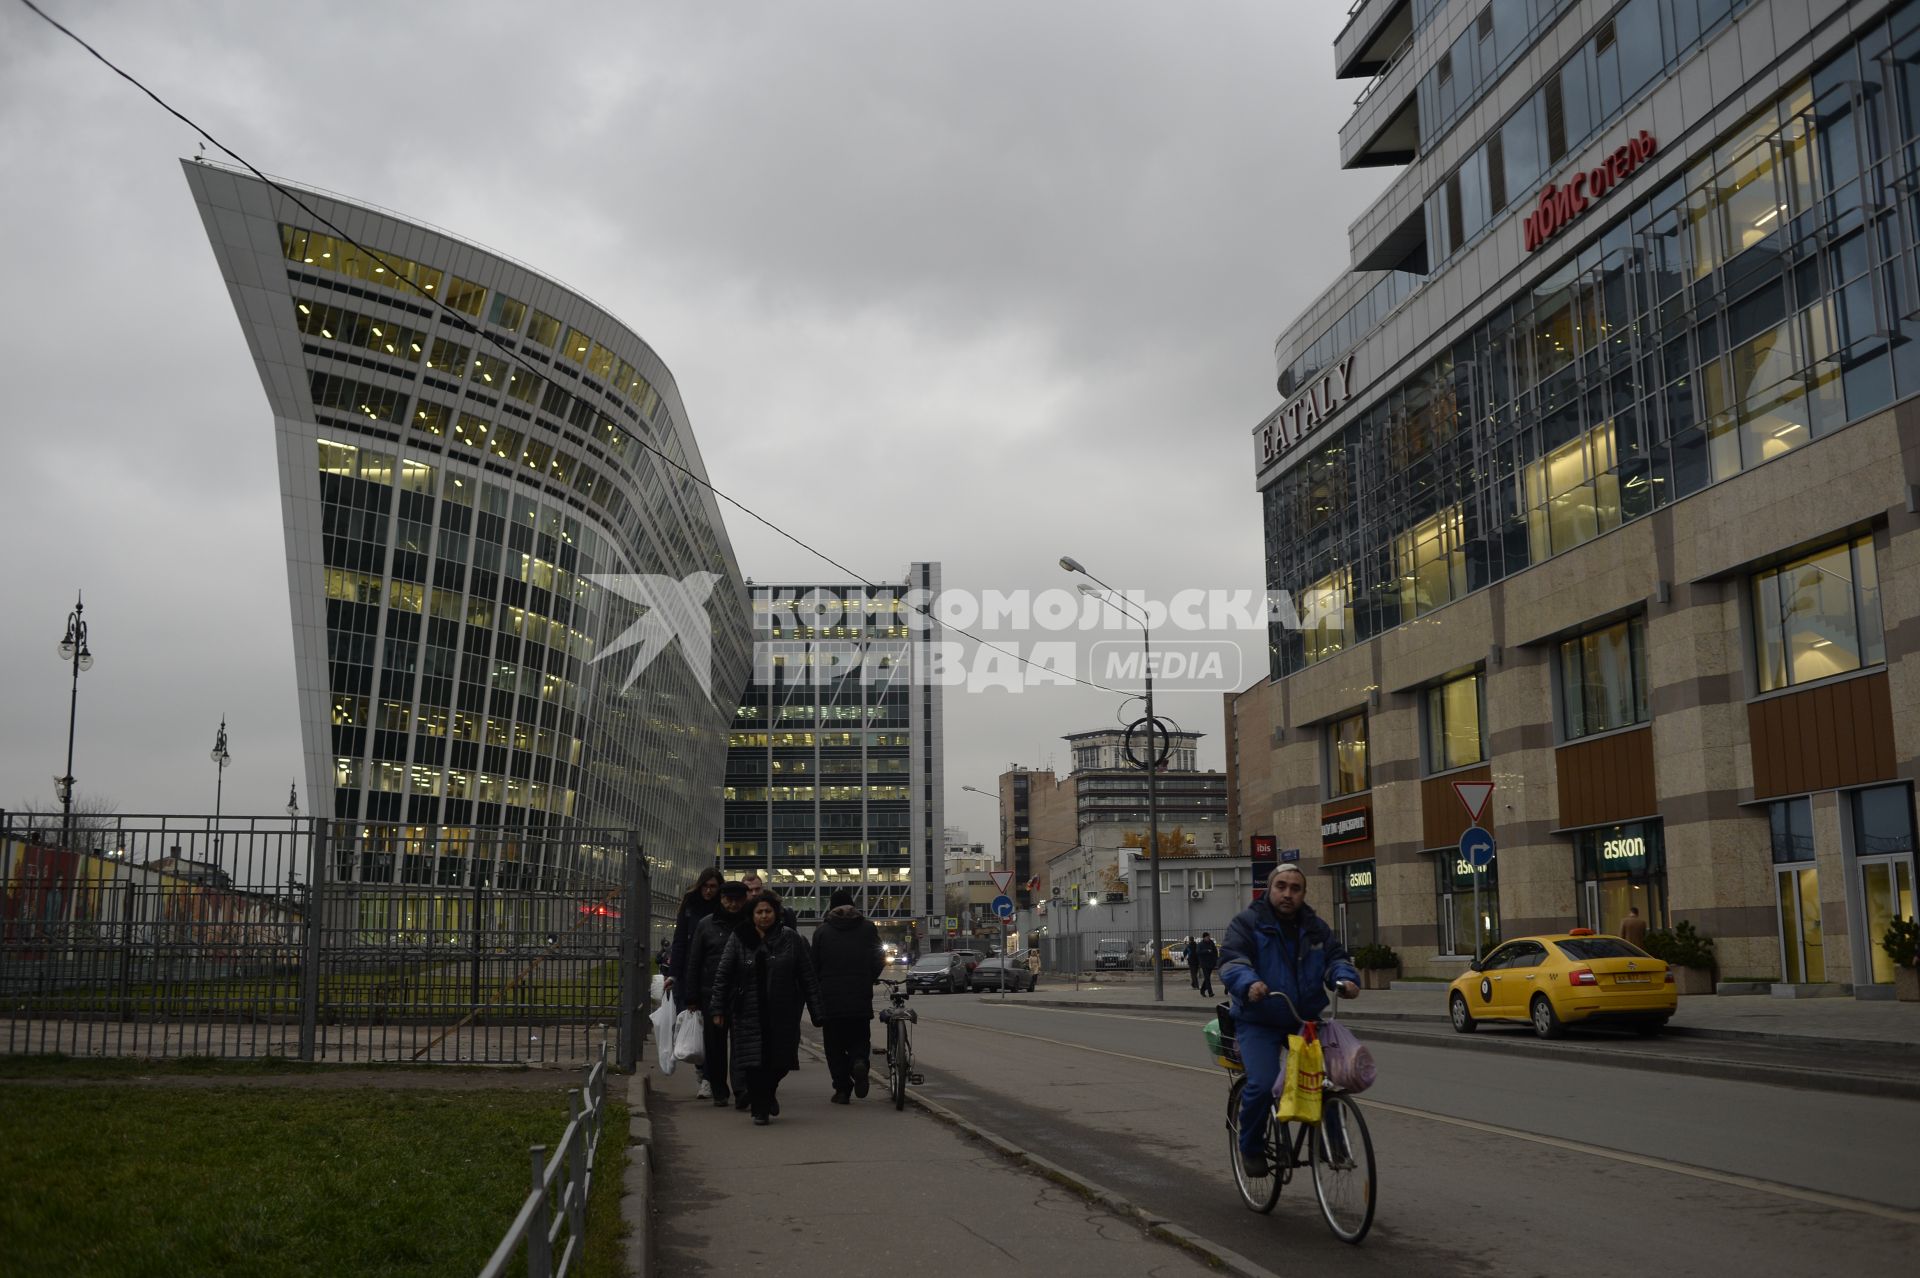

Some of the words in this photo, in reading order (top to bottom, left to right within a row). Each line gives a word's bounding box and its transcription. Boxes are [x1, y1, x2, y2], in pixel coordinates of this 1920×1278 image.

[1262, 354, 1355, 465] EATALY
[1256, 843, 1272, 853] ibis
[1603, 837, 1646, 860] askon
[1349, 871, 1372, 887] askon
